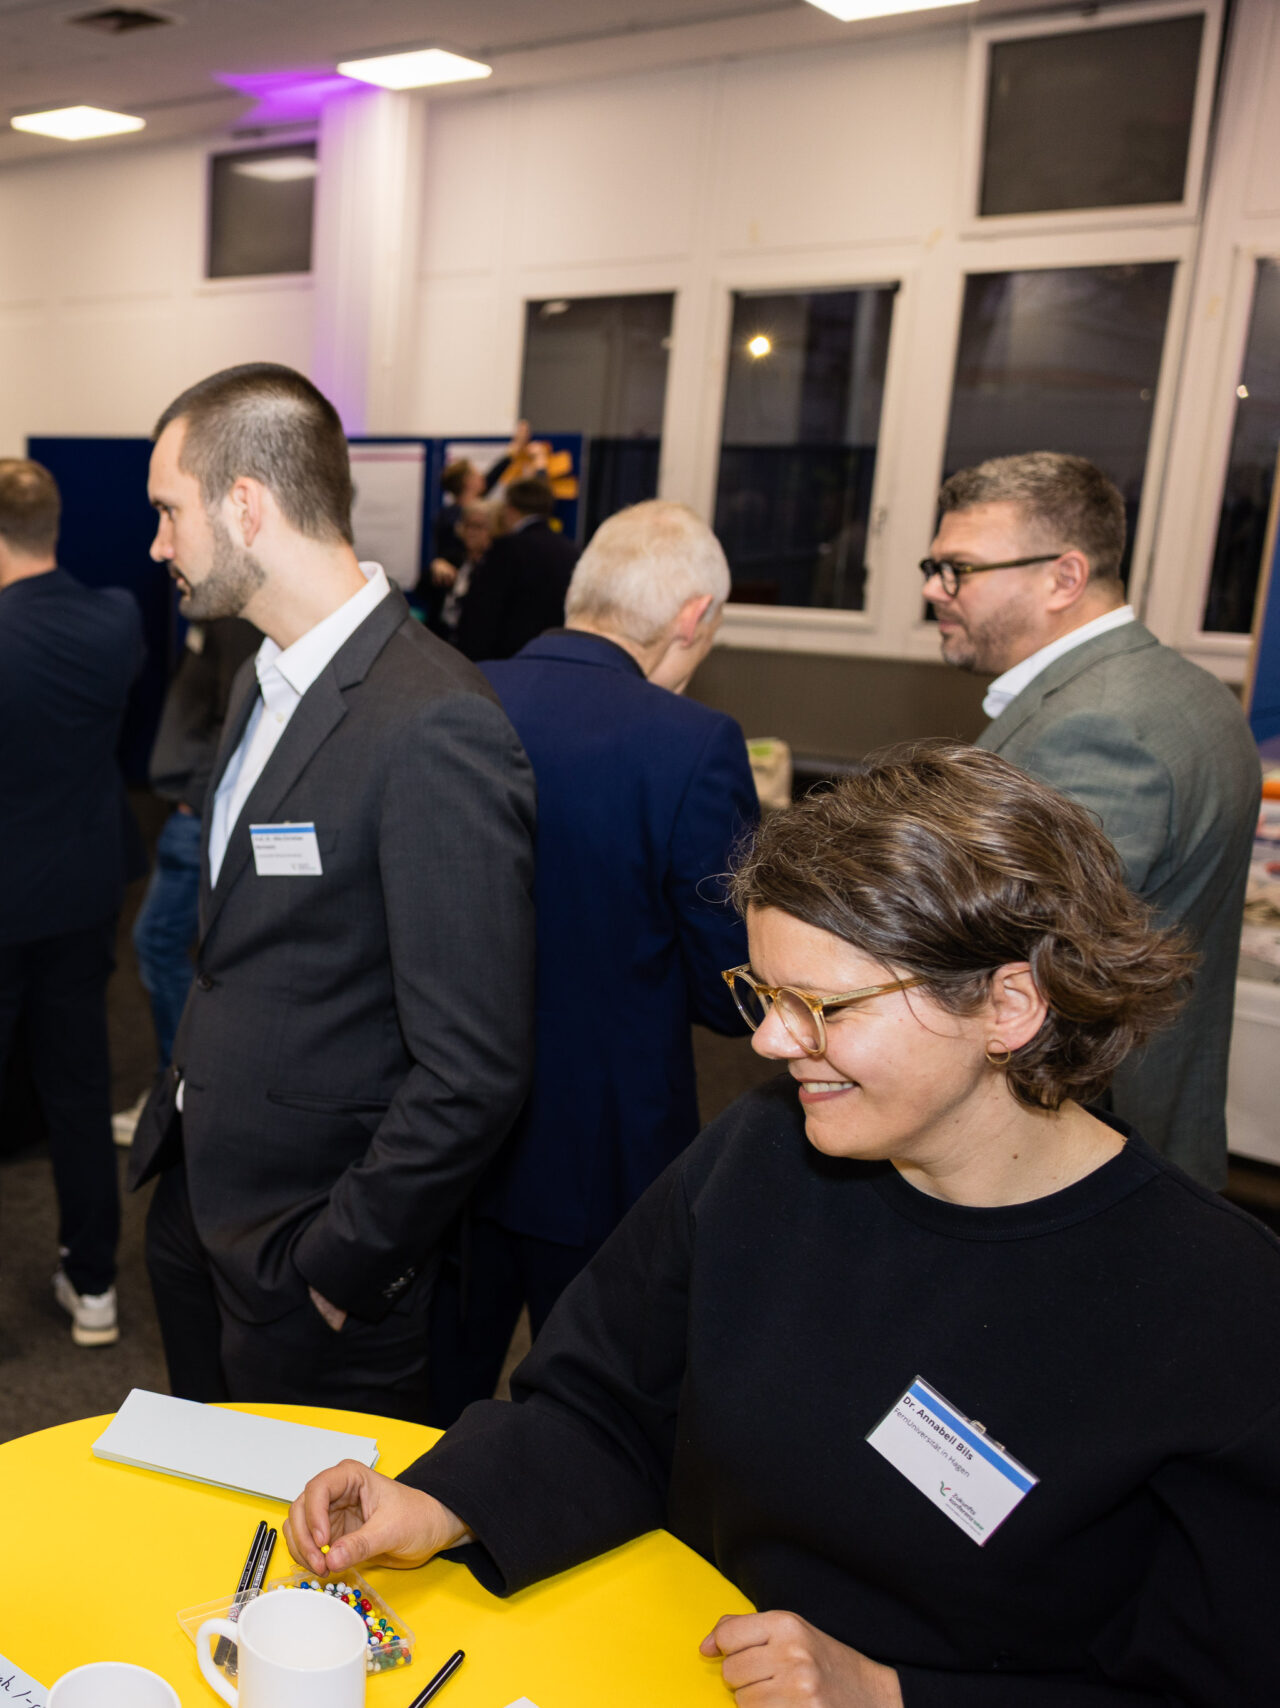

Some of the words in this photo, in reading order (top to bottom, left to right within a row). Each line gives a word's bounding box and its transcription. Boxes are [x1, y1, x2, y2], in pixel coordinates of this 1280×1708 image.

[902, 1396, 915, 1411] Dr.
[916, 1409, 958, 1445] Annabell
[955, 1442, 974, 1461] Bils
[941, 1449, 949, 1458] in
[948, 1456, 970, 1477] Hagen
